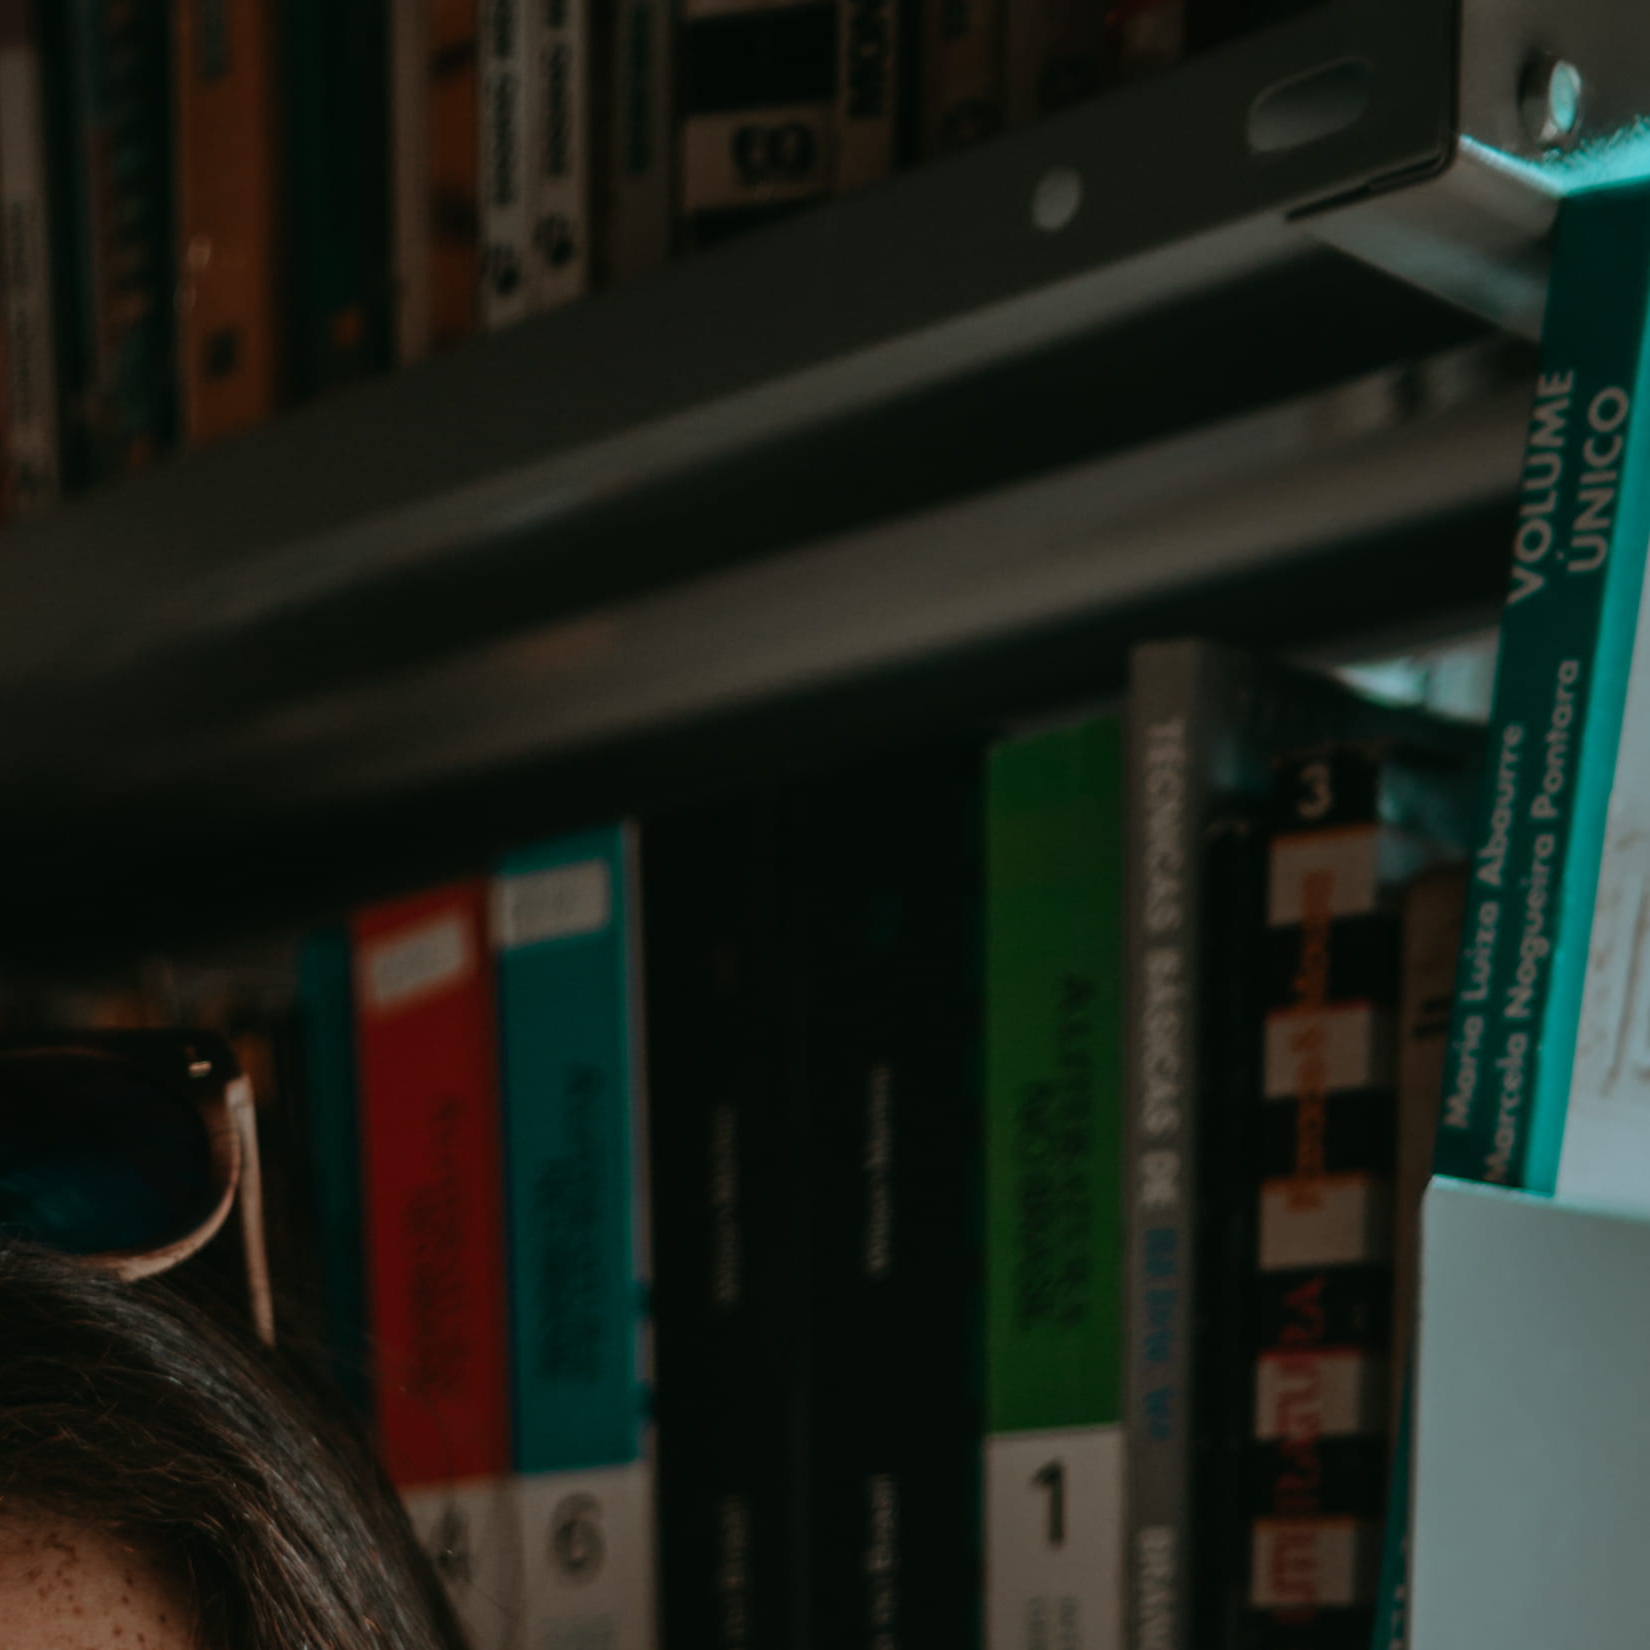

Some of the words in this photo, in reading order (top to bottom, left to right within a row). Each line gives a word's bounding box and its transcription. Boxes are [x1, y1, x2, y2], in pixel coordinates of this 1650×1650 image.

[1508, 369, 1575, 605] VOLUME
[1561, 384, 1629, 574] ÚNICO
[1295, 760, 1335, 820] 3
[1475, 721, 1525, 888] Abaurre
[1530, 658, 1580, 820] Pontara
[1459, 899, 1500, 1002] Luiza
[1503, 832, 1558, 1020] Nogueira
[1444, 1013, 1485, 1130] Maria
[1032, 1459, 1067, 1548] 1
[1268, 1274, 1326, 1627] LITERATURA
[548, 1490, 606, 1585] 6
